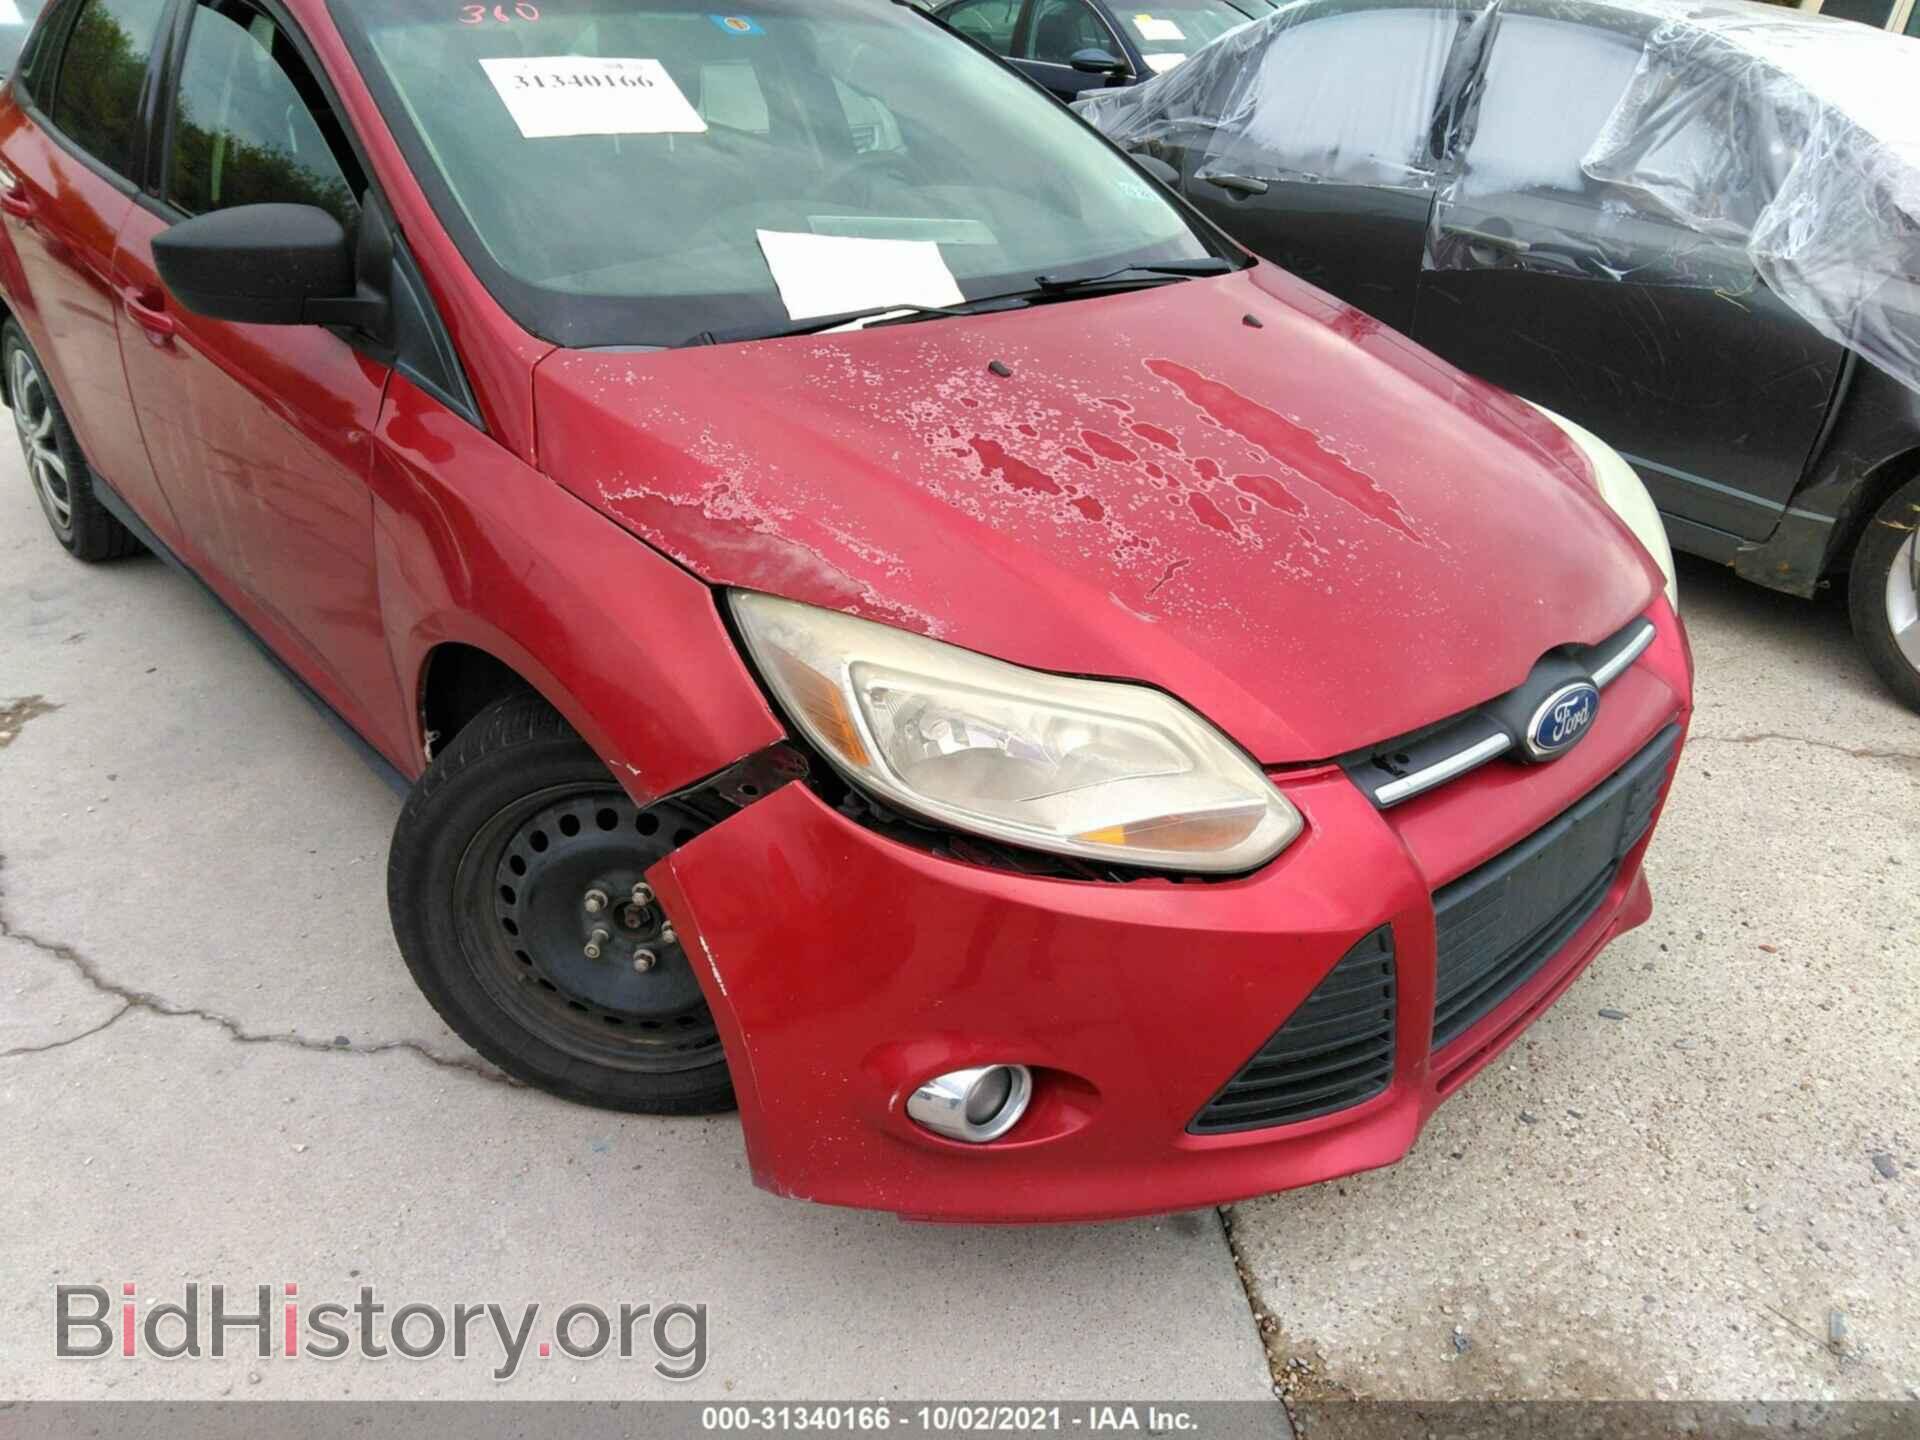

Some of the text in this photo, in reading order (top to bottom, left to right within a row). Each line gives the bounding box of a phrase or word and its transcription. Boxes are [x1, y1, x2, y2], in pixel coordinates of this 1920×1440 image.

[457, 3, 540, 24] 360
[513, 74, 654, 88] 31340166
[1552, 695, 1590, 742] Ford
